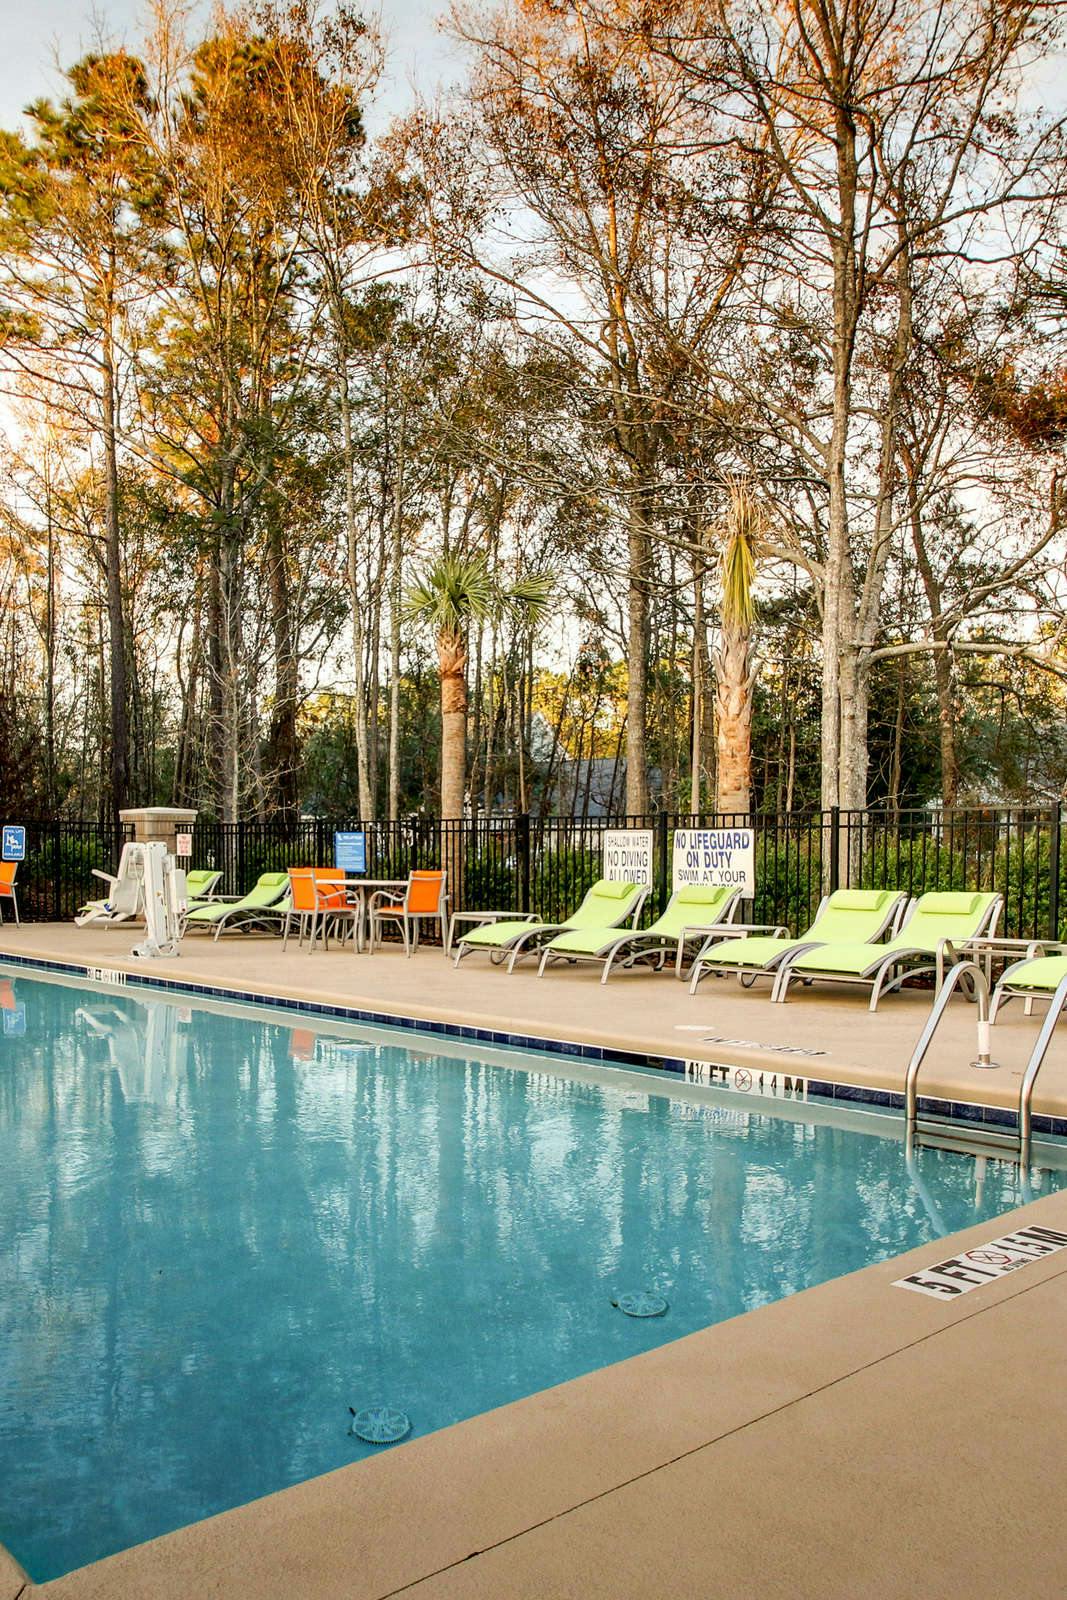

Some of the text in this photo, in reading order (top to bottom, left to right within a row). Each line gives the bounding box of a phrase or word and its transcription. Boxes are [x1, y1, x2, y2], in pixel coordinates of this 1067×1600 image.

[608, 836, 648, 847] SHALLOW WATER
[675, 832, 750, 849] NO LIFEGUARD
[608, 850, 648, 867] NO DIVING
[686, 851, 732, 868] ON DUTY
[678, 869, 746, 882] SWIM AT YOUR
[928, 1259, 998, 1285] FT
[903, 1275, 962, 1294] 5
